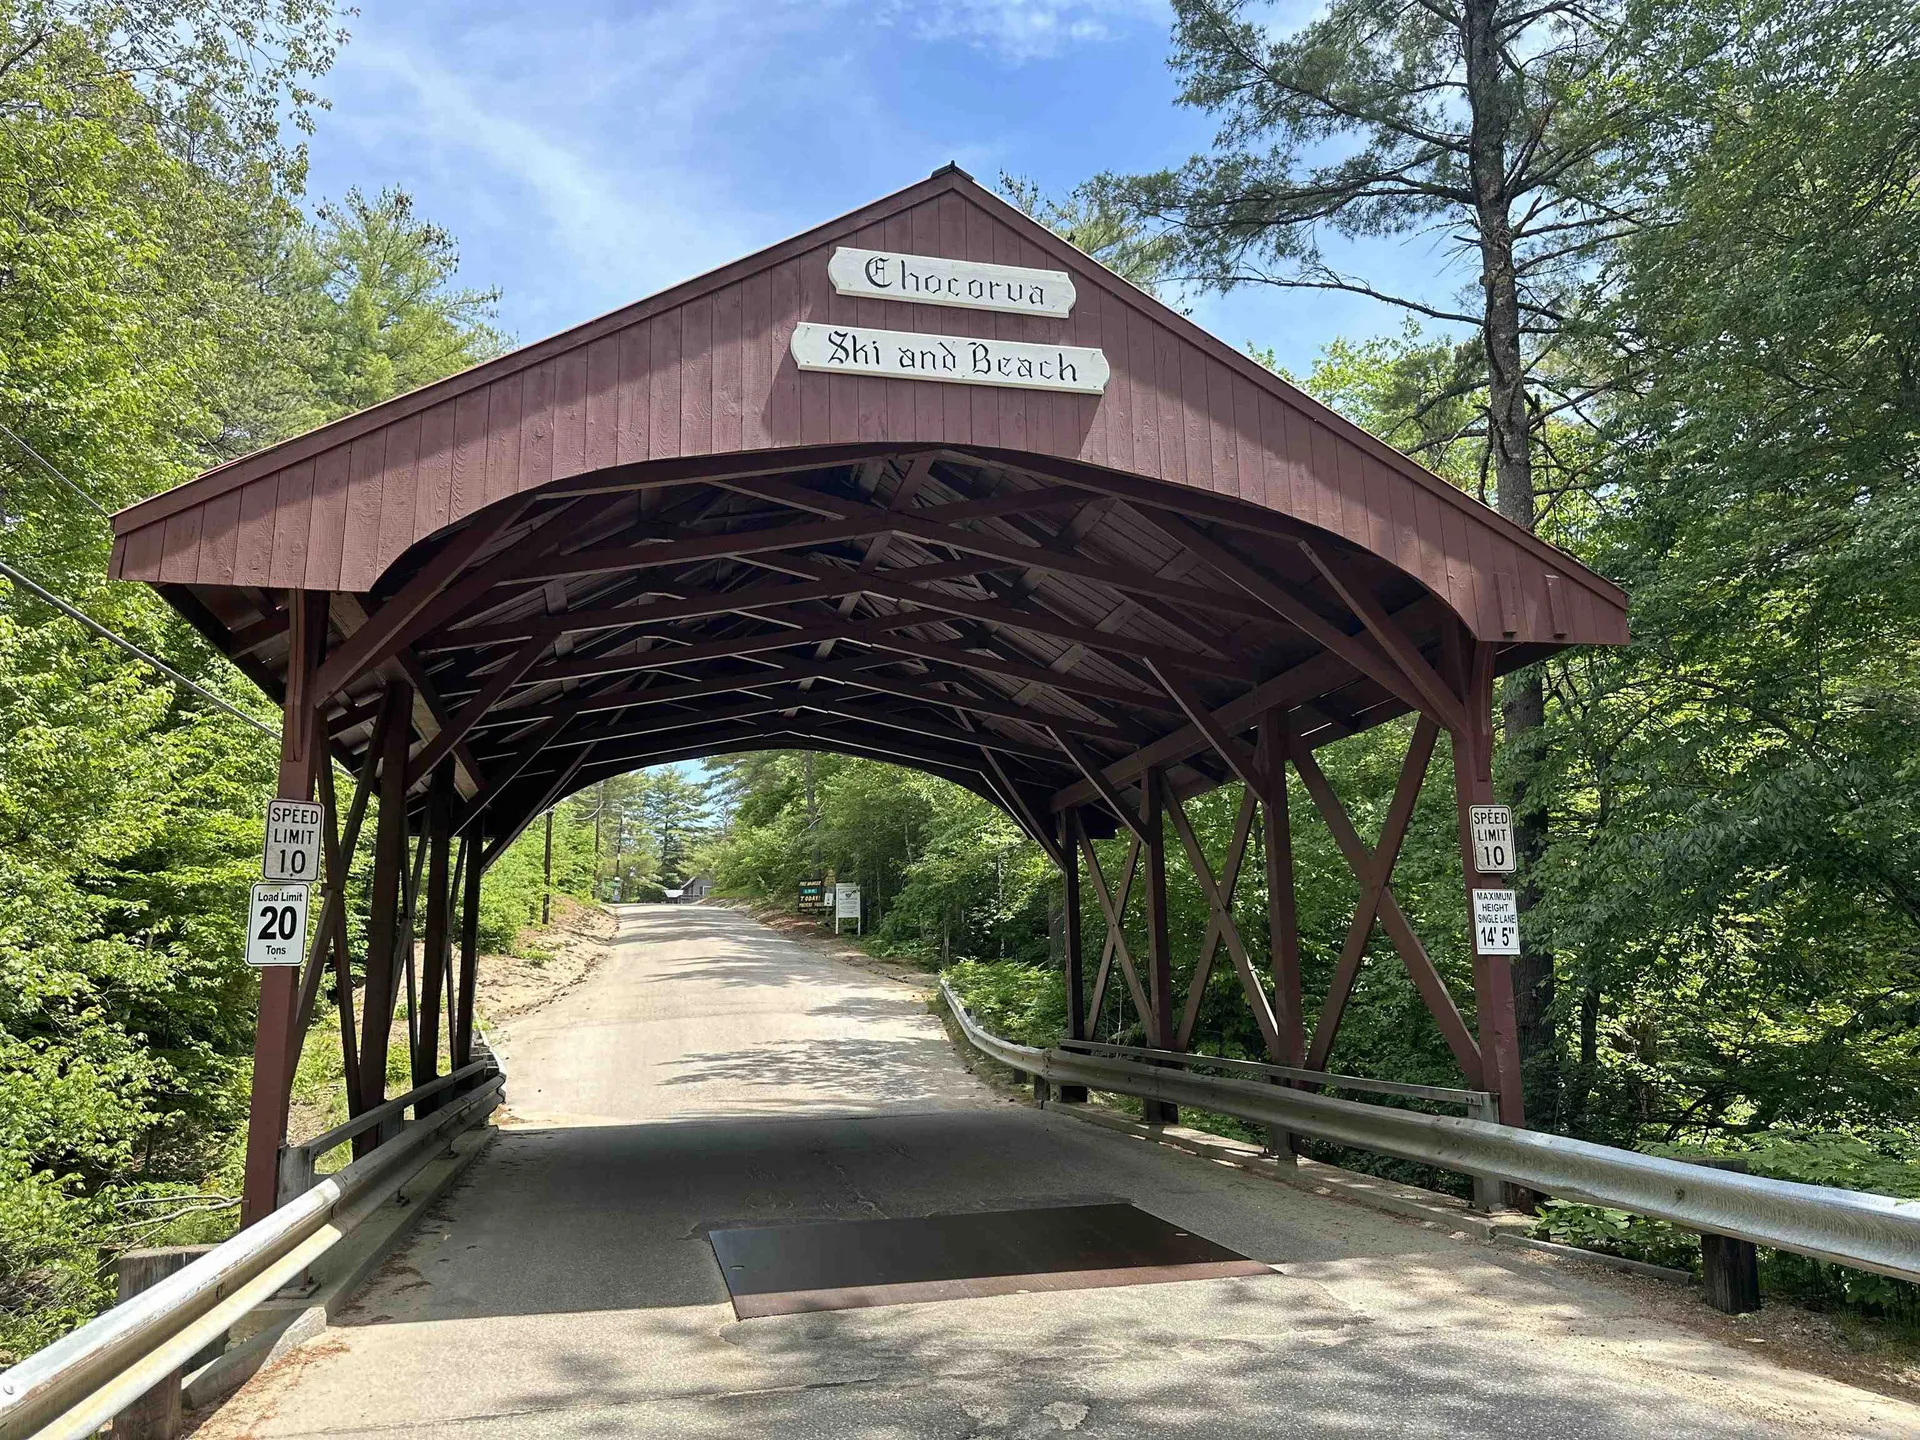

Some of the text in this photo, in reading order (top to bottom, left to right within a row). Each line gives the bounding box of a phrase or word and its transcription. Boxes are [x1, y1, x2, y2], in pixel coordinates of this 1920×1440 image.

[827, 330, 1078, 382] Ski and Beach
[271, 807, 319, 825] SPEED
[1473, 811, 1508, 825] SPEED
[273, 828, 315, 845] LIMIT
[1477, 829, 1507, 842] LIMIT
[279, 849, 306, 874] 10
[1484, 845, 1505, 866] 10
[257, 892, 303, 902] Load Limit
[1476, 892, 1513, 901] MAXIMUM
[1482, 903, 1509, 912] HEIGHT
[257, 906, 297, 940] 20
[1477, 914, 1516, 923] SINGLE LANE
[1480, 926, 1515, 946] 14' 5"
[265, 945, 286, 955] Tons
